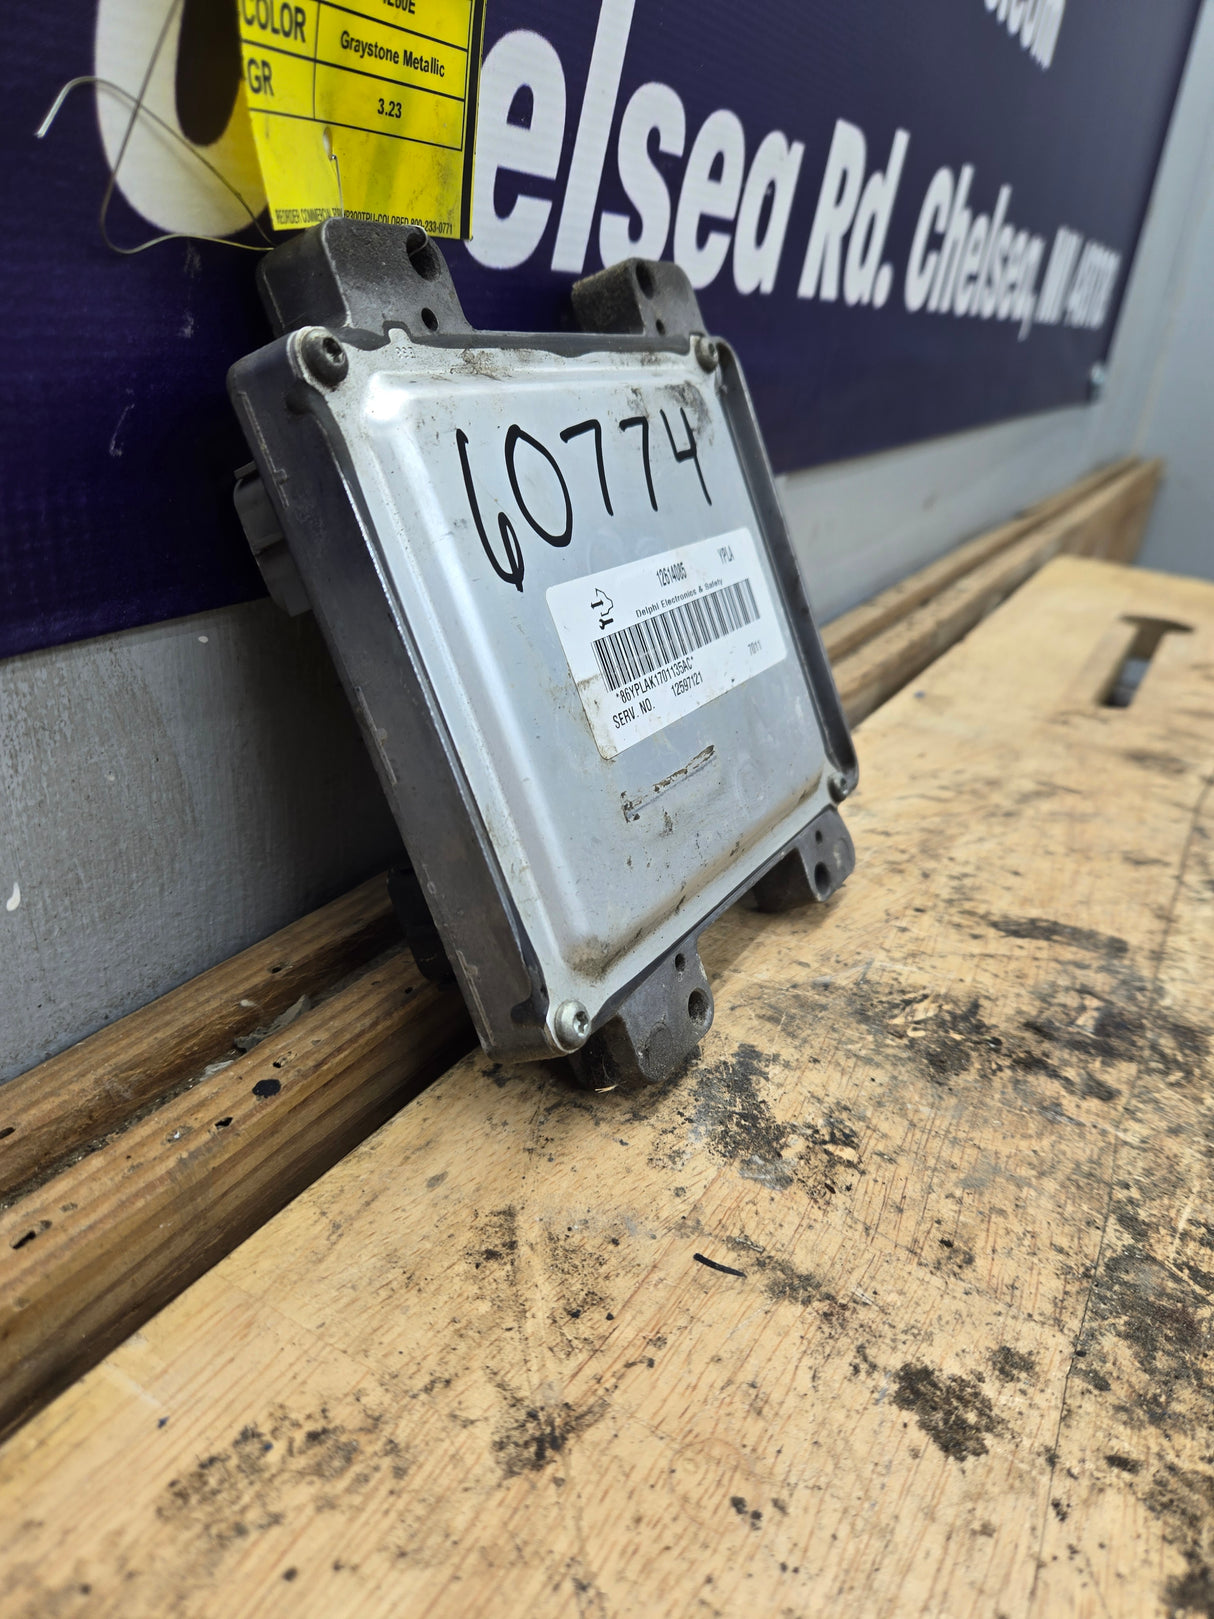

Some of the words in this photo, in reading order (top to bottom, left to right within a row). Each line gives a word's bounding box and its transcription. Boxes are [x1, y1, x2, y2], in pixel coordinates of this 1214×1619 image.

[242, 0, 306, 43] COLOR
[340, 30, 400, 64] Graystone
[402, 49, 446, 78] Metallic
[247, 57, 274, 97] GR
[377, 98, 402, 119] 3.23
[797, 117, 910, 310] Rd.
[904, 163, 1045, 342] Chelsea,
[455, 407, 712, 593] 60774
[635, 602, 659, 618] Delphi
[661, 588, 697, 607] Electronics
[698, 585, 703, 593] &
[704, 578, 723, 591] Safety
[612, 706, 639, 729] SERV.
[639, 697, 655, 714] NO.
[671, 671, 703, 697] 12597121
